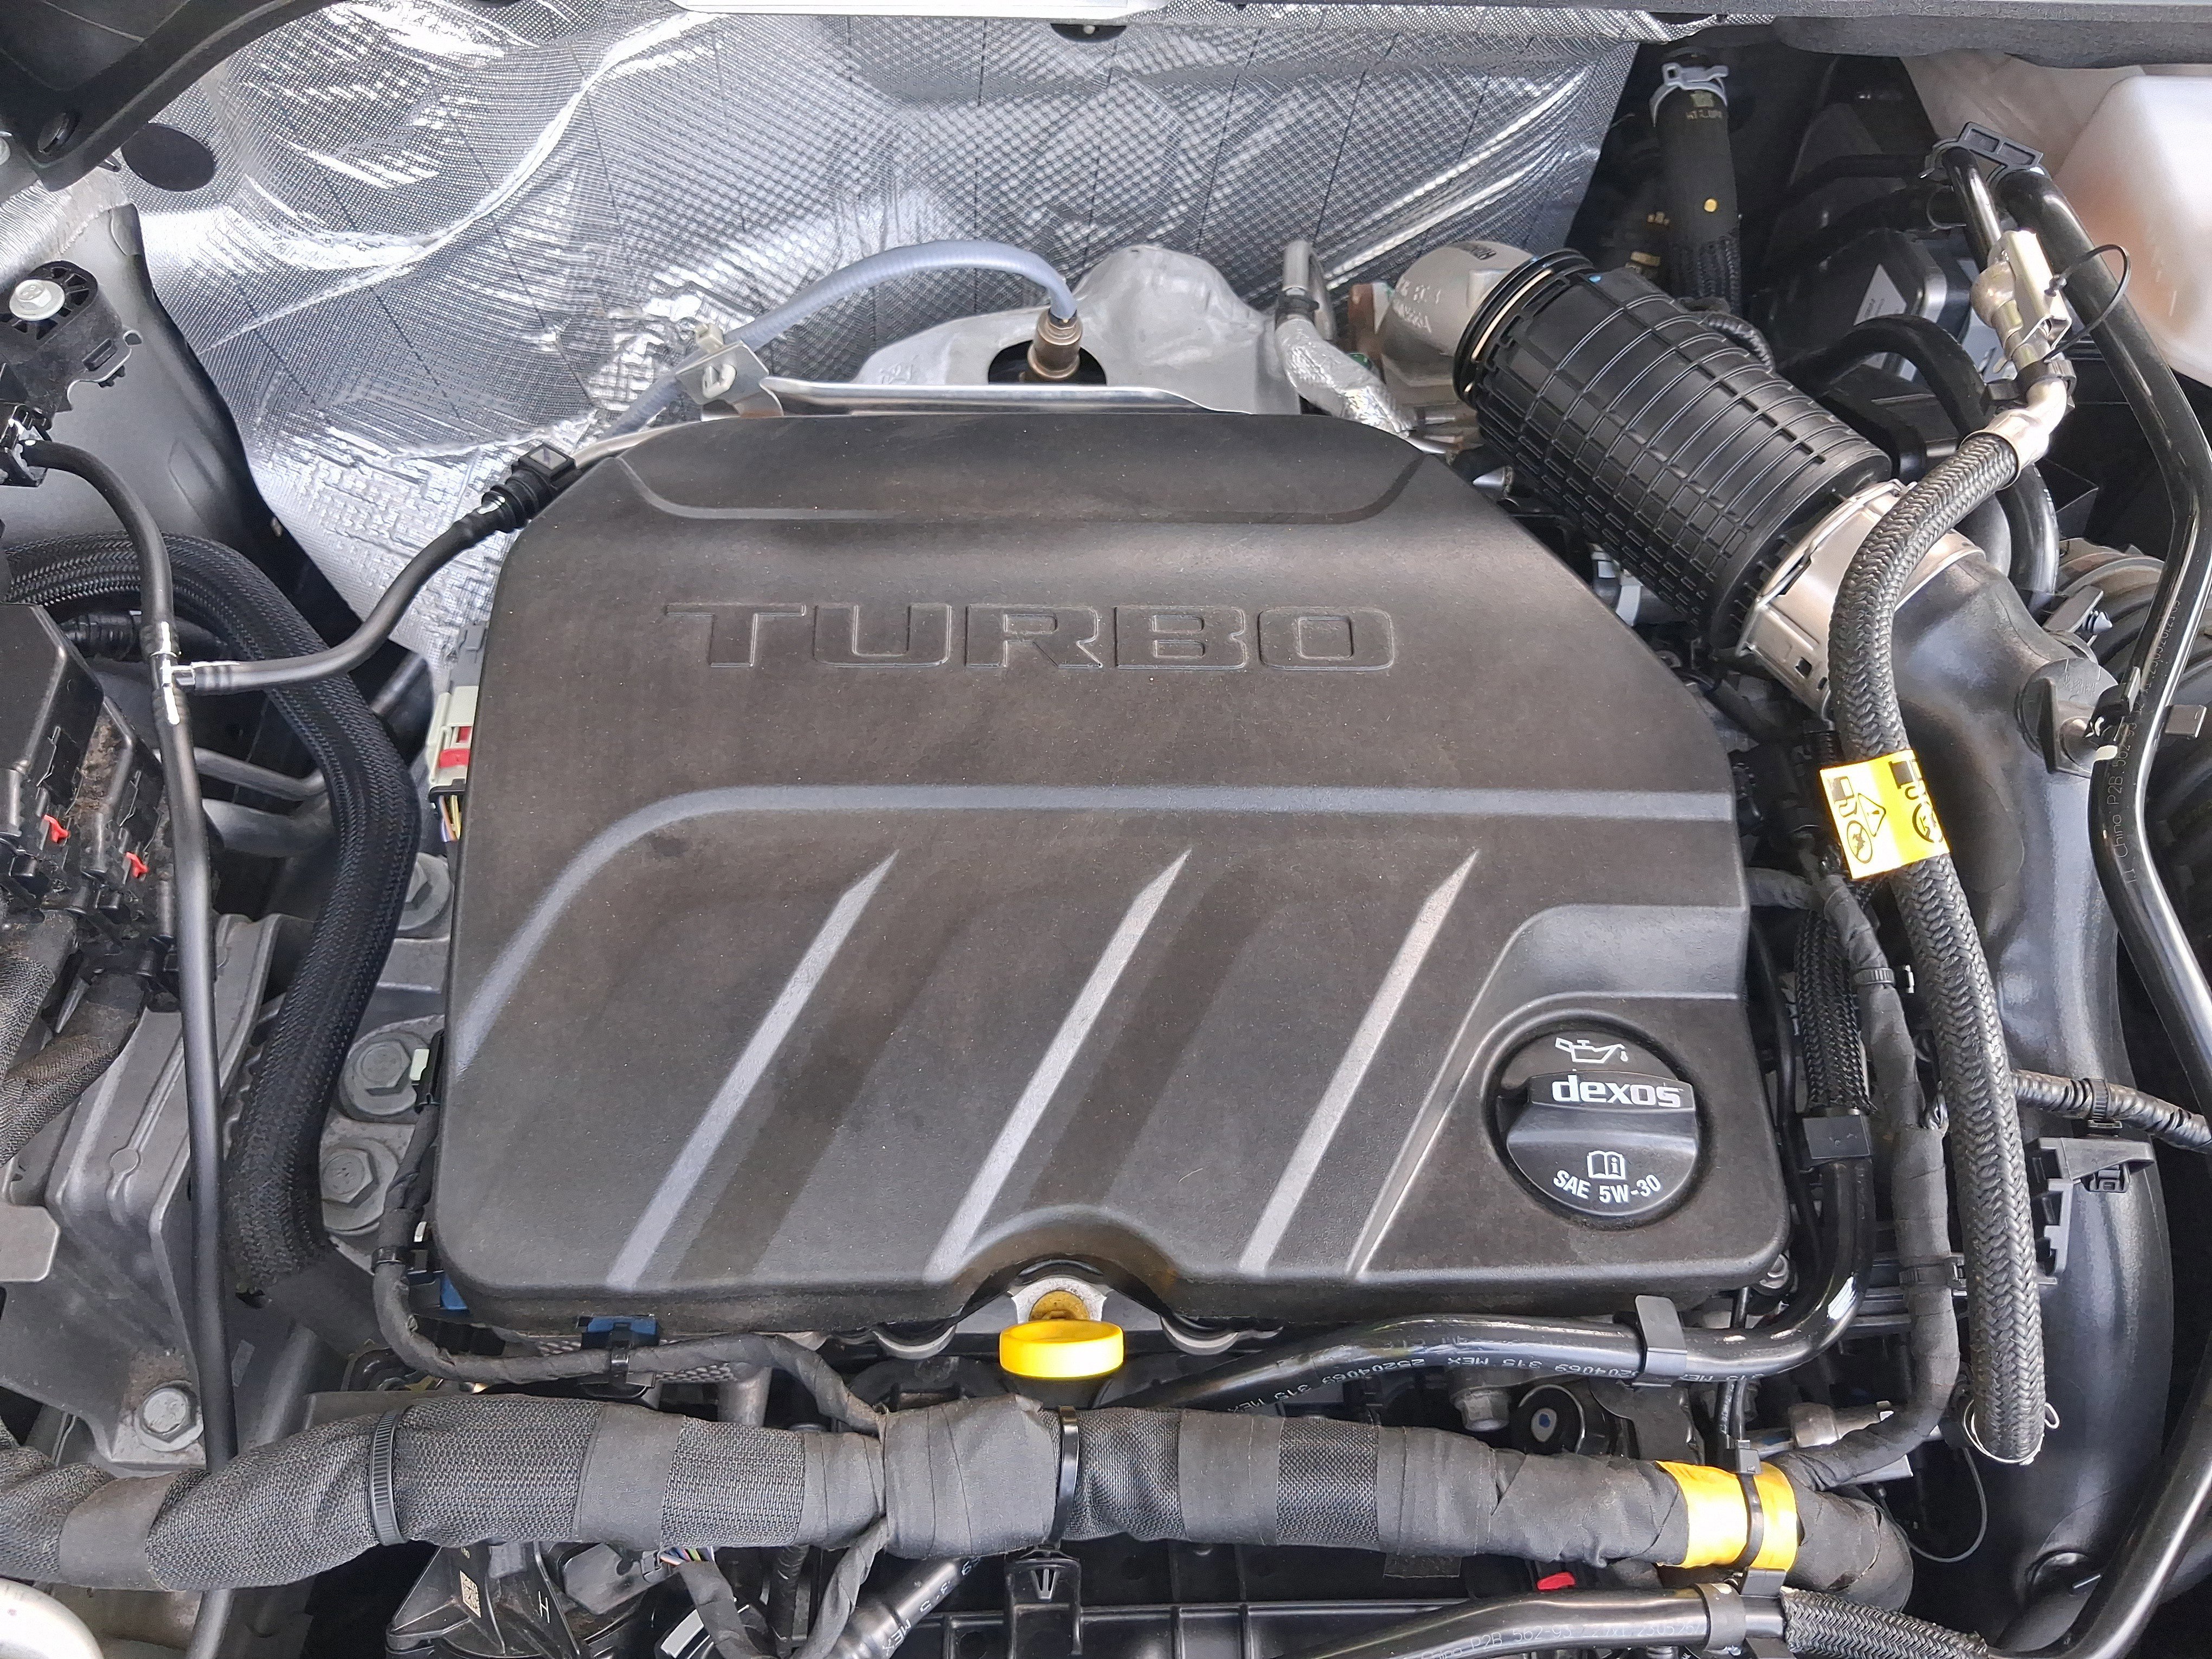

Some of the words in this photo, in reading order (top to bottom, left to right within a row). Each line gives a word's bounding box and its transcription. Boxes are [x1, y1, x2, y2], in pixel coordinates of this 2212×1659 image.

[665, 602, 1396, 671] TURBO
[2113, 814, 2128, 859] Chino
[1551, 1075, 1681, 1108] dexos
[1553, 1169, 1591, 1199] SAE
[1598, 1174, 1662, 1204] 5W-30
[1321, 1358, 1425, 1385] 25204069
[1447, 1356, 1489, 1366] MEX
[1502, 1358, 1542, 1369] 315
[1554, 1363, 1638, 1377] 204069
[1274, 1384, 1312, 1401] 315
[882, 1618, 911, 1657] MEX
[1470, 1631, 1503, 1650] P2B
[1512, 1625, 1572, 1643] 562-93
